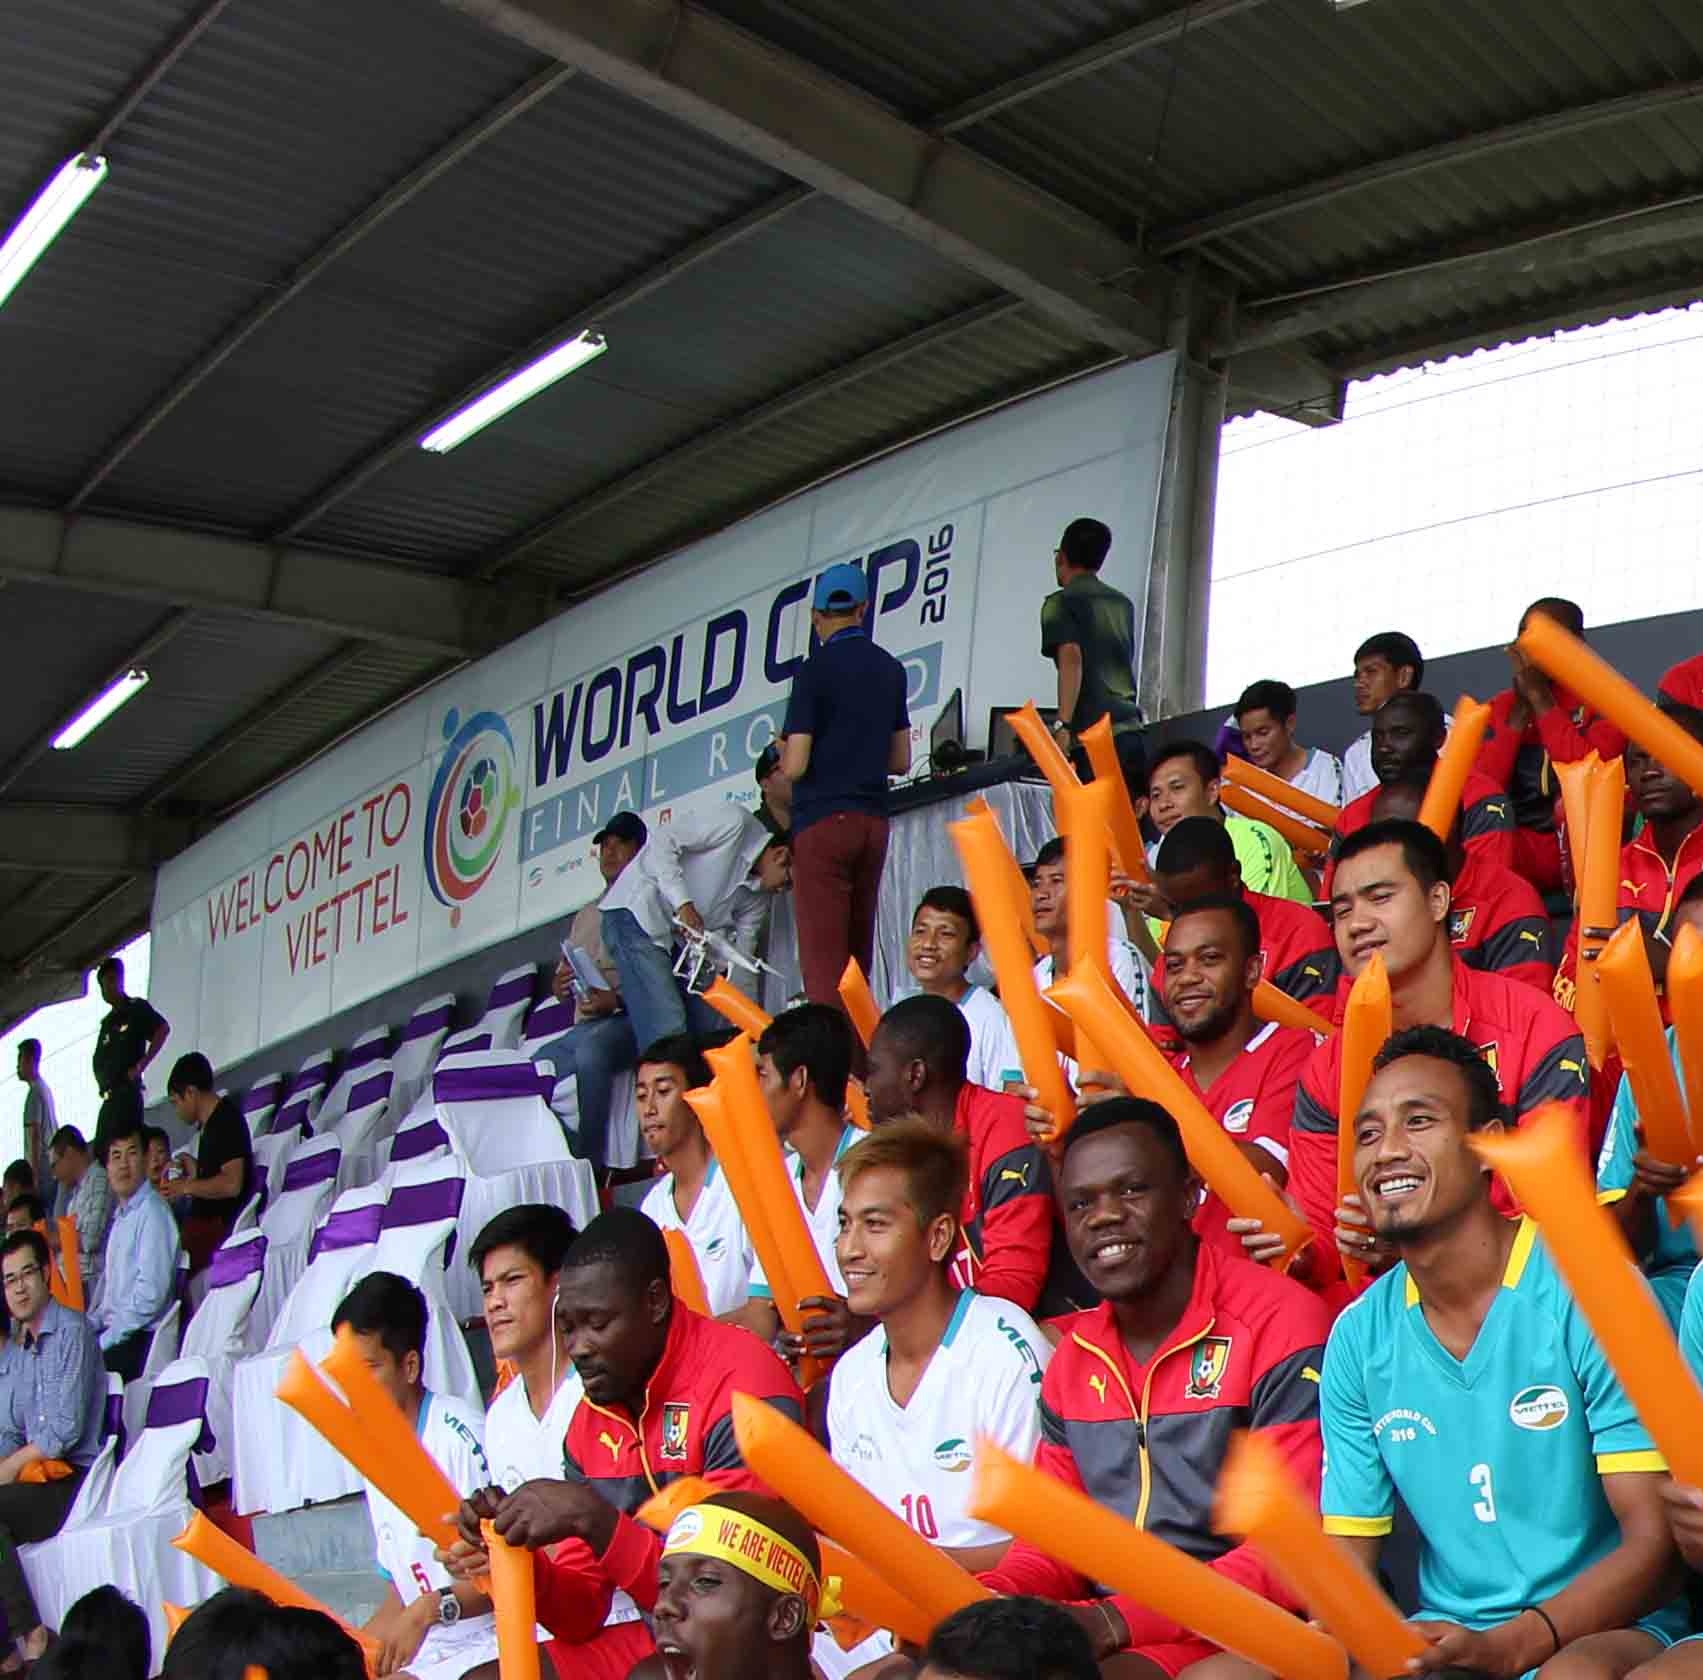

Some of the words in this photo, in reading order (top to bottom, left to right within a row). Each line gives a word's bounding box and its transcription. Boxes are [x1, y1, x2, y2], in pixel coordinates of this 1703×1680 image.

[920, 522, 955, 626] 2016
[534, 608, 748, 787] WORLD
[764, 537, 921, 685] CP
[528, 755, 666, 851] FINAL
[706, 654, 928, 777] ROD
[207, 810, 355, 949] WELCOME
[361, 782, 412, 858] TO
[286, 863, 409, 977] VIETTEL
[1513, 1401, 1567, 1417] VIETTEL
[717, 1518, 738, 1546] WE
[738, 1529, 767, 1567] ARE
[900, 1493, 939, 1540] 10
[1469, 1462, 1498, 1524] 3
